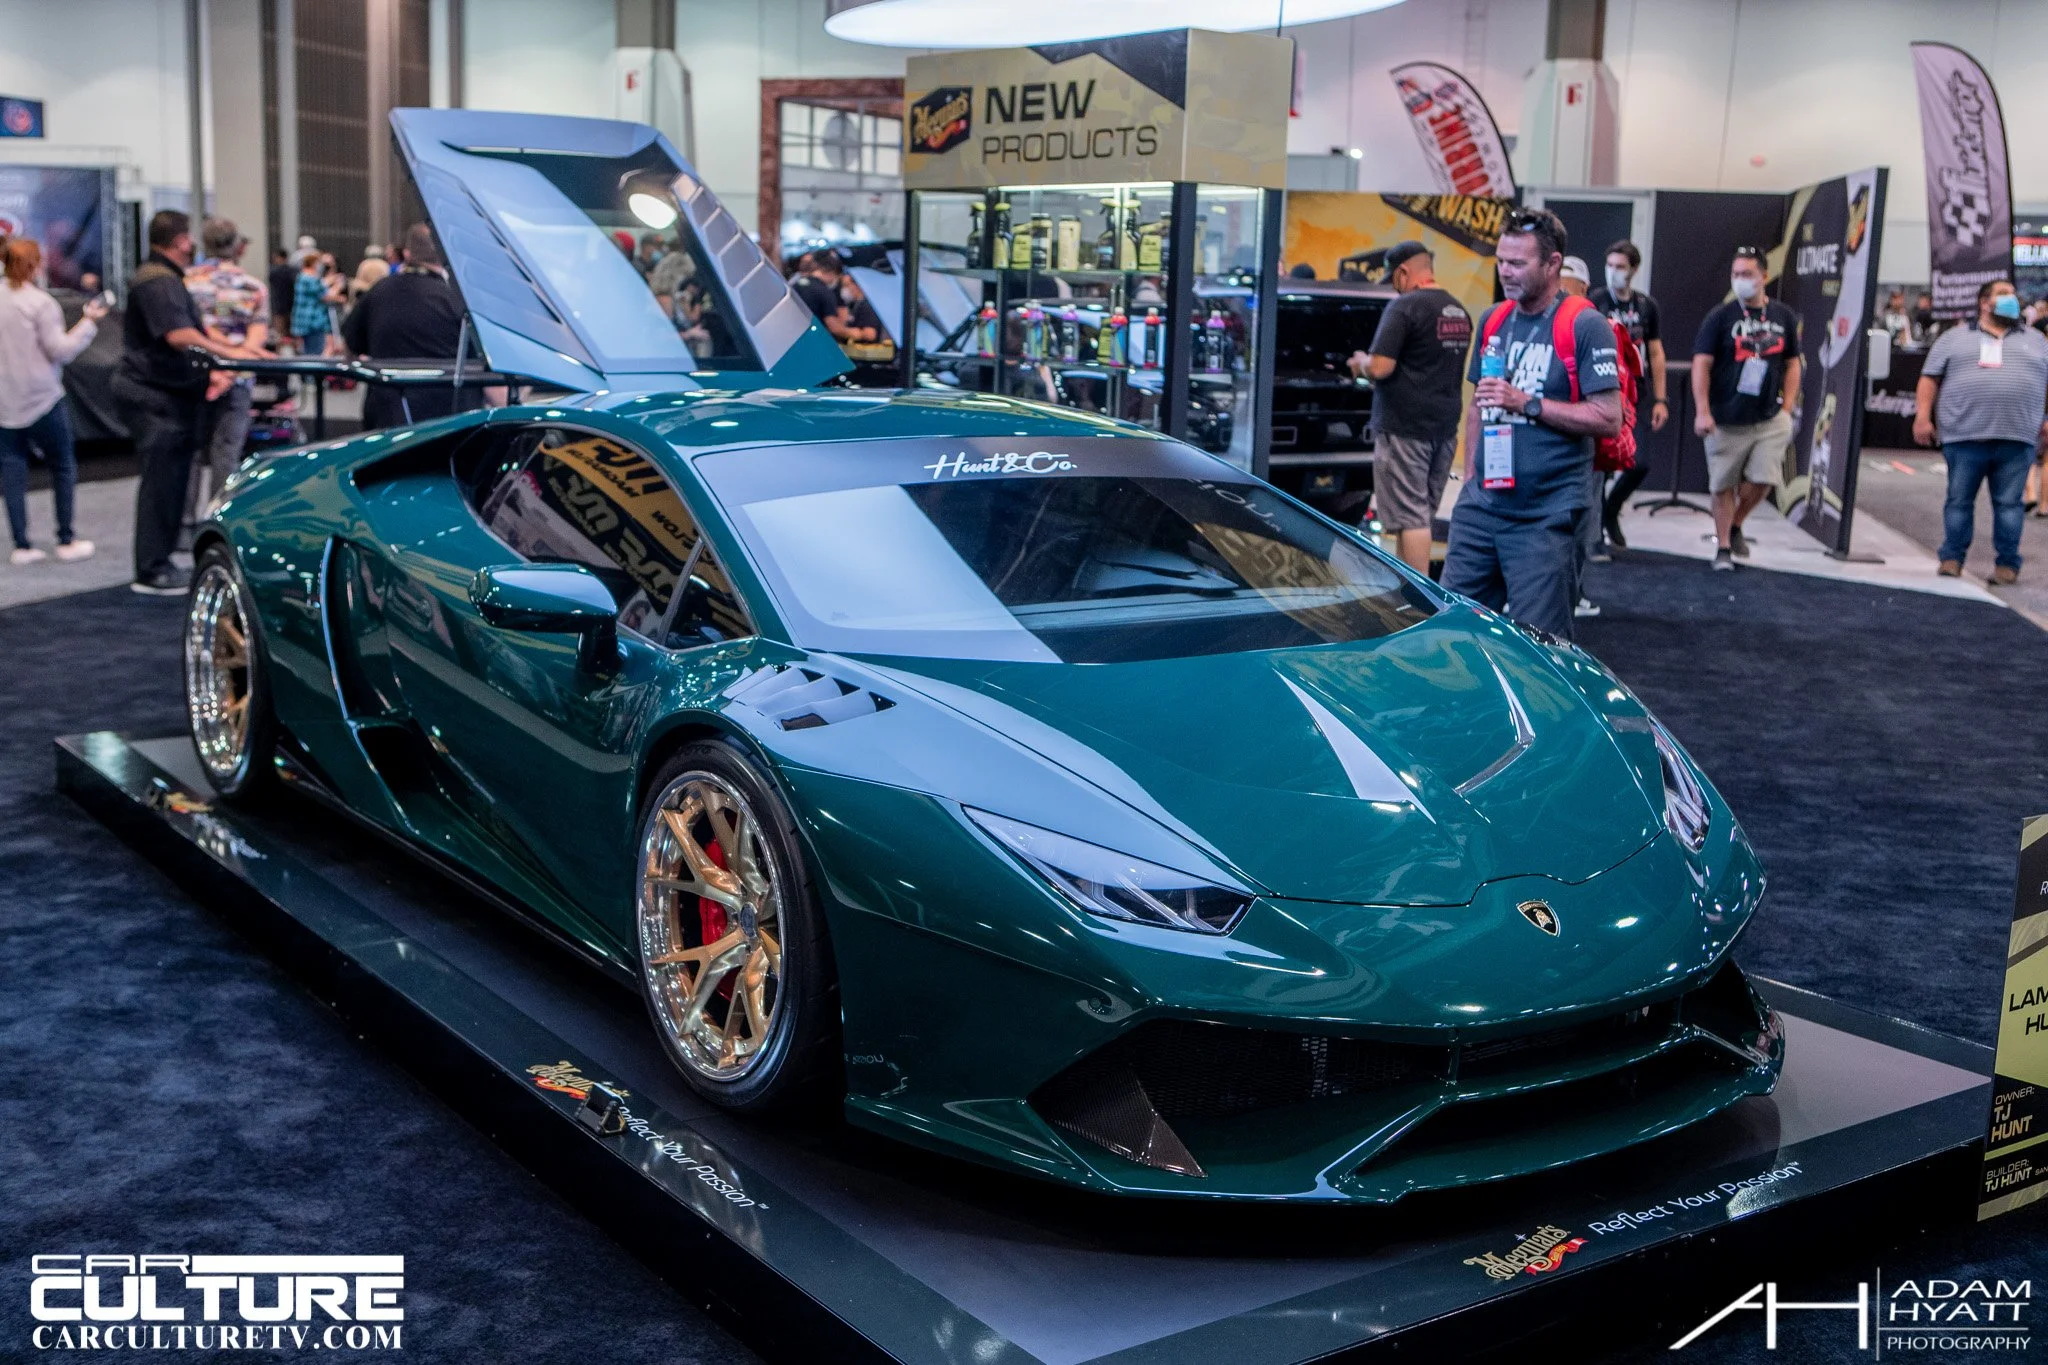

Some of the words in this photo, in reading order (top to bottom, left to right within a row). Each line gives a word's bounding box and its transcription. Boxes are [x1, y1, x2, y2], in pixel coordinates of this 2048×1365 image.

[985, 79, 1096, 124] NEW
[982, 126, 1158, 165] PRODUCTS
[2039, 880, 2048, 896] R
[1995, 1086, 2035, 1105] OWNER:
[1993, 1103, 2012, 1124] TJ
[1990, 1114, 2033, 1143] HUNT
[1985, 1178, 1999, 1193] TJ
[2000, 1166, 2033, 1188] HUNT
[1986, 1159, 2030, 1181] BUILDER:
[1587, 1205, 1674, 1235] Reflect
[1667, 1189, 1721, 1210] Your
